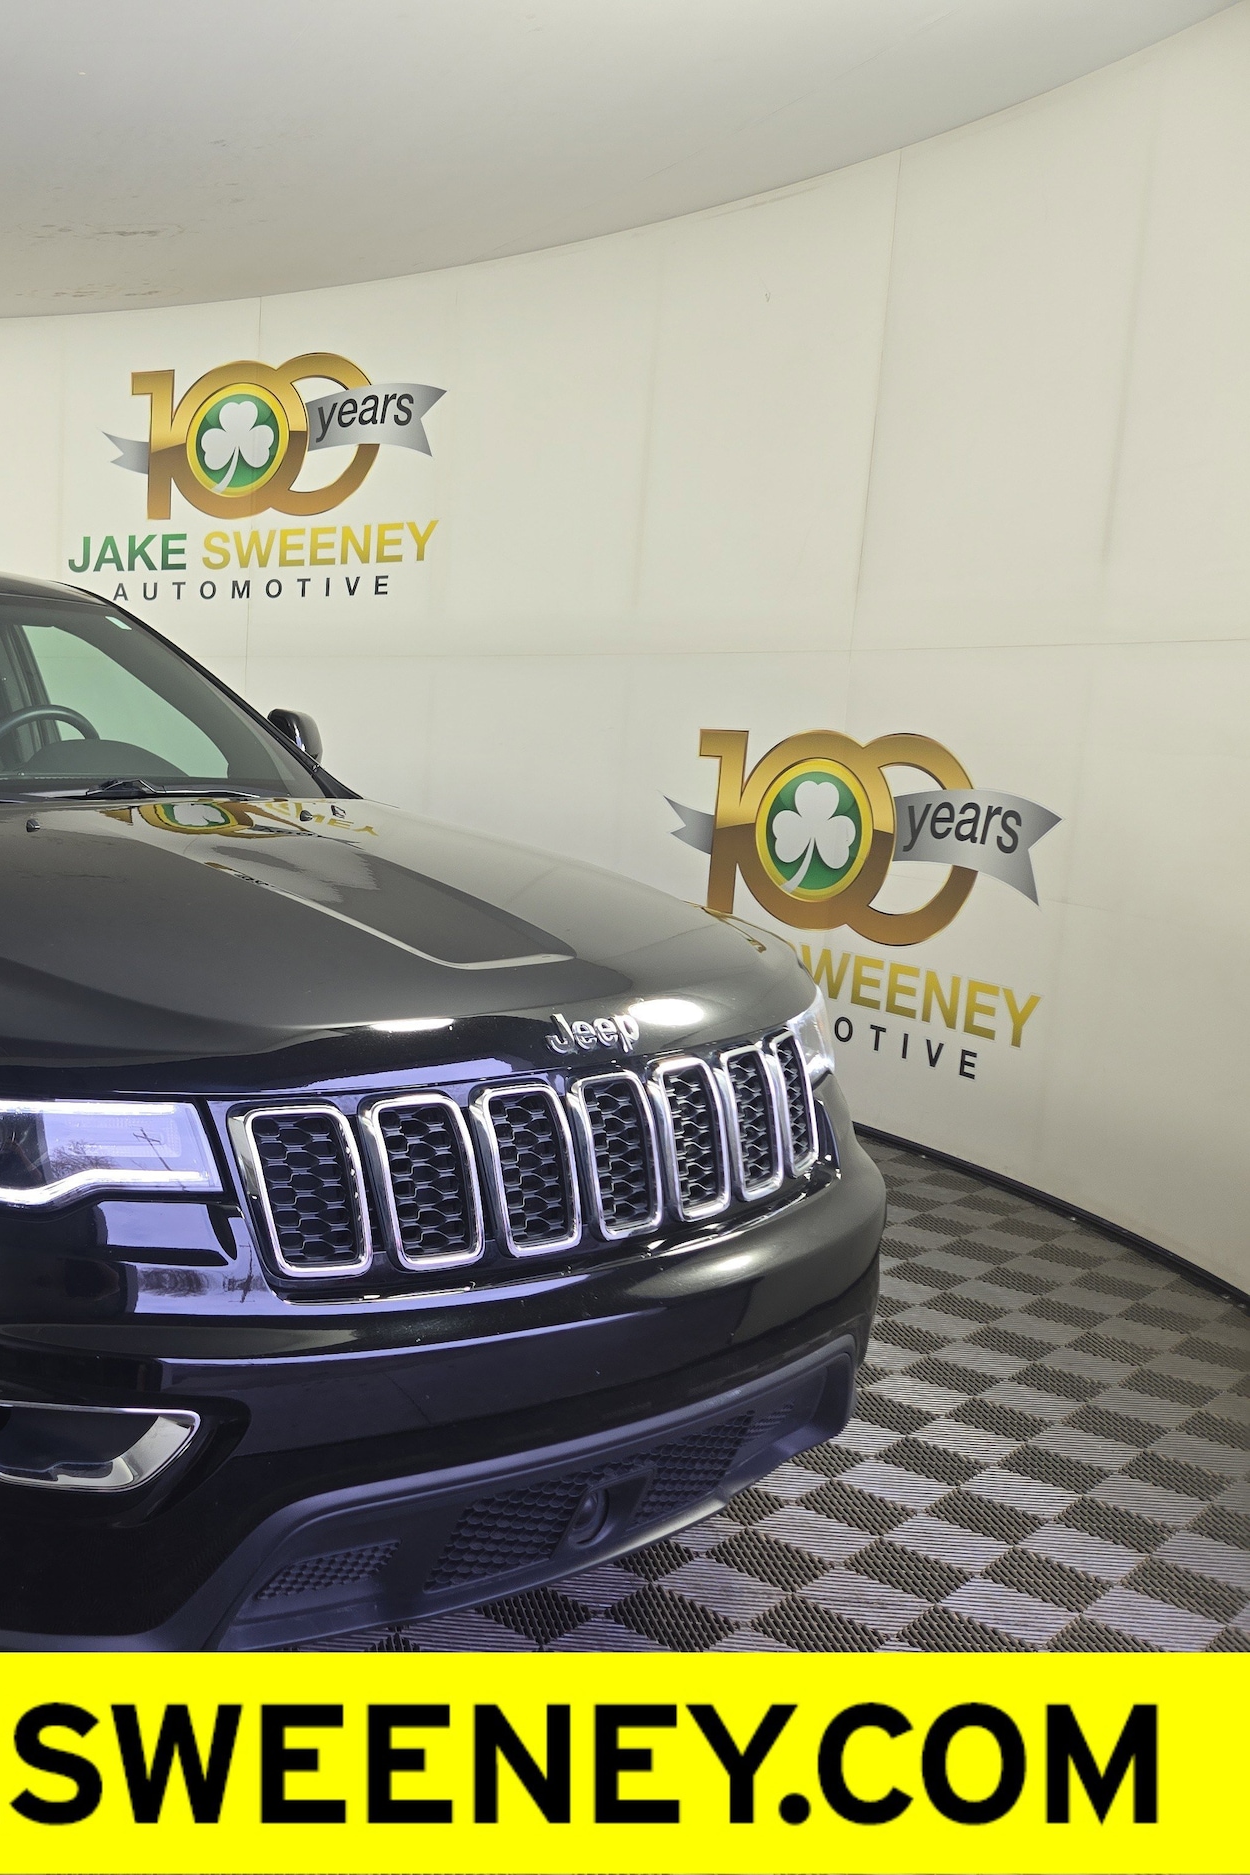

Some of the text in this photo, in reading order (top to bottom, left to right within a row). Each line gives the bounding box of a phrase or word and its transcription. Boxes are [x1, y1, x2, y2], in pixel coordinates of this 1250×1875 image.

[131, 352, 414, 520] 100 years
[68, 520, 439, 573] JAKE SWEENEY
[113, 575, 389, 601] AUTOMOTIVE
[699, 728, 1022, 946] 100 years
[801, 944, 1041, 1048] WEENEY
[545, 1013, 639, 1053] Jeep
[834, 1016, 978, 1079] OTIVE
